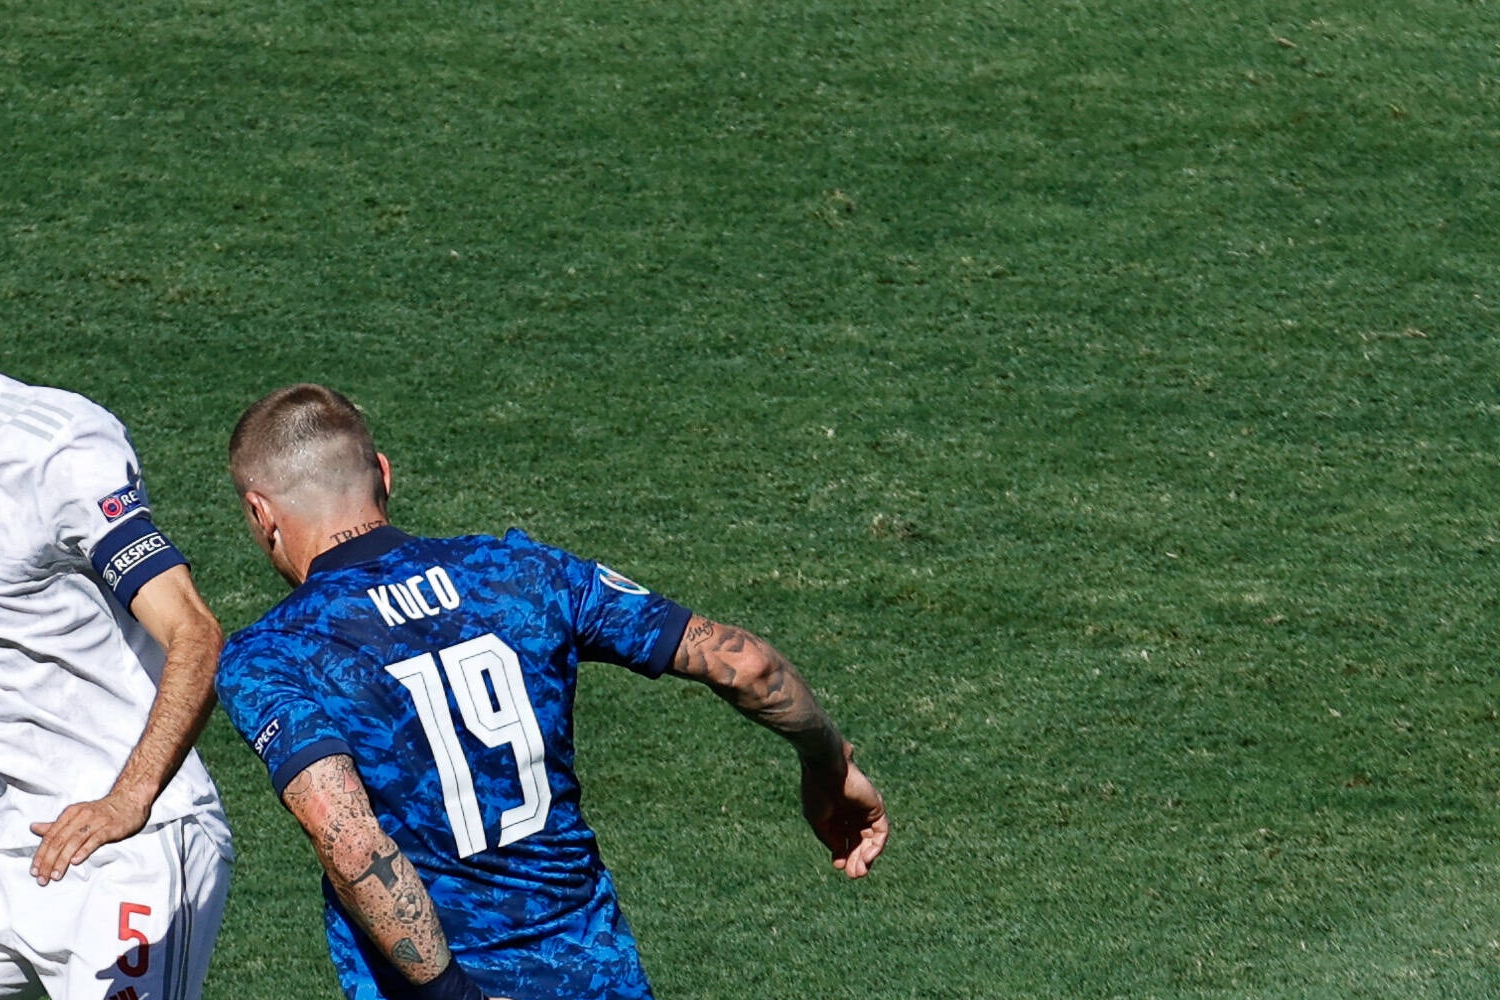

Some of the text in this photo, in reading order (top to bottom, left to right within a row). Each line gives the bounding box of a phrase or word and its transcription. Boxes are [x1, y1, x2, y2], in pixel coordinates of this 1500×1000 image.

[113, 535, 166, 572] RESPECT
[366, 565, 460, 627] KUCO
[383, 632, 552, 860] 19
[116, 901, 152, 978] 5
